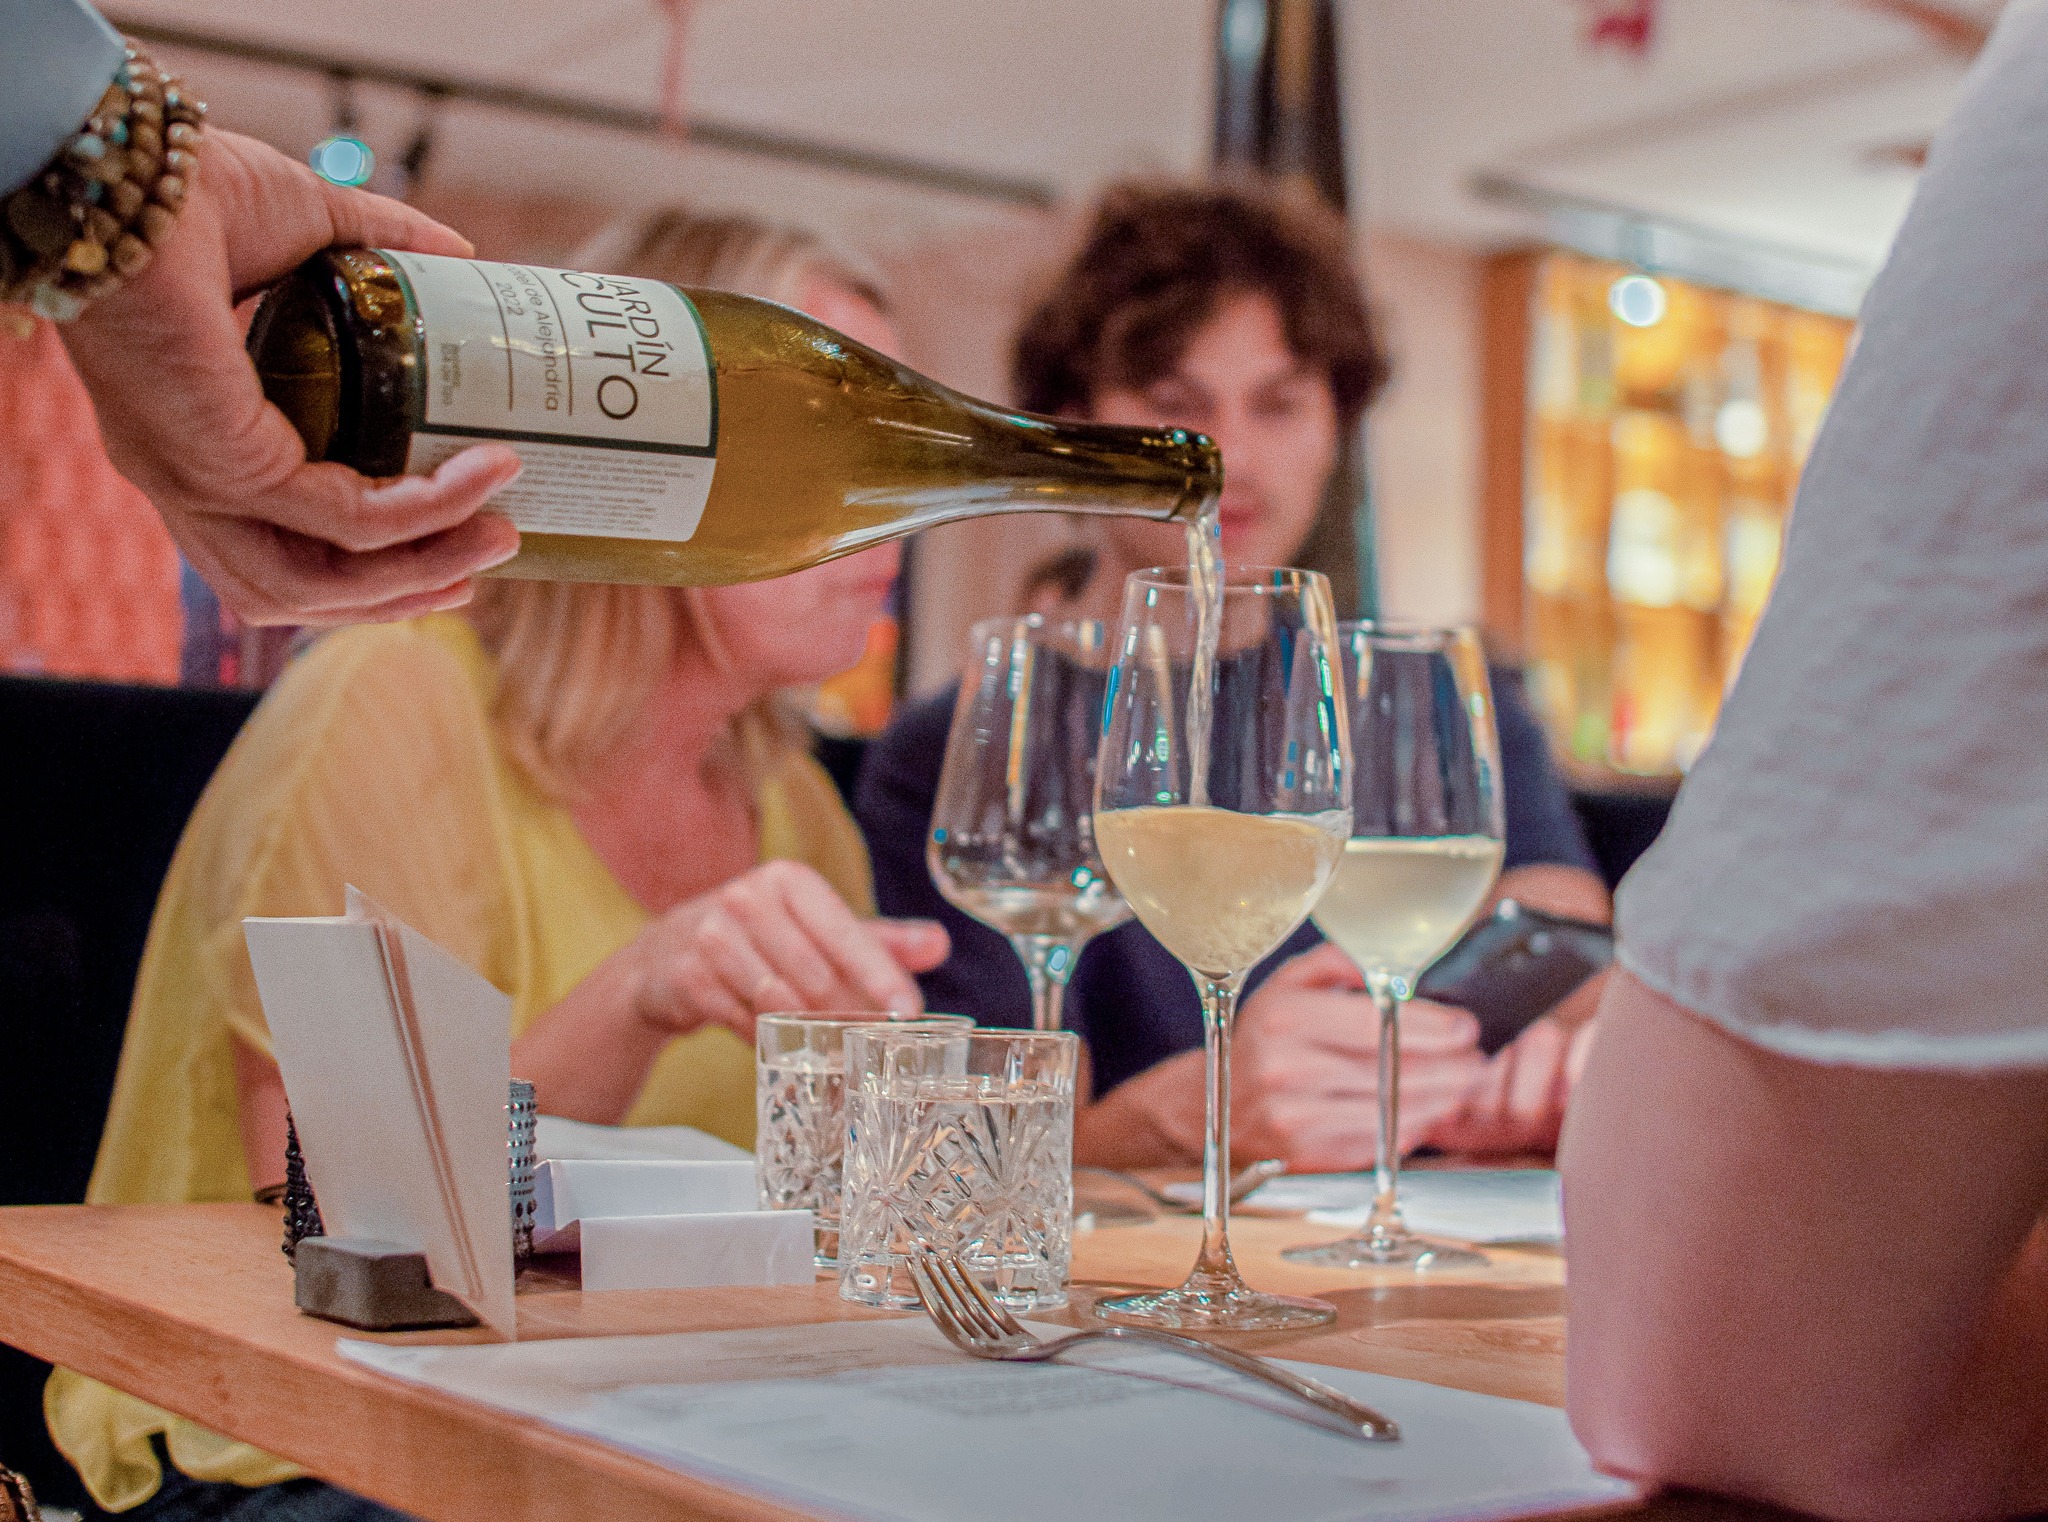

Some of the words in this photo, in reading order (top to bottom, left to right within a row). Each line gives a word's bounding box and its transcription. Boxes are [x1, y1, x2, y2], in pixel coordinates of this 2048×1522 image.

[496, 281, 524, 317] 2022
[560, 271, 639, 420] CULTO
[600, 276, 673, 377] JARDÍN
